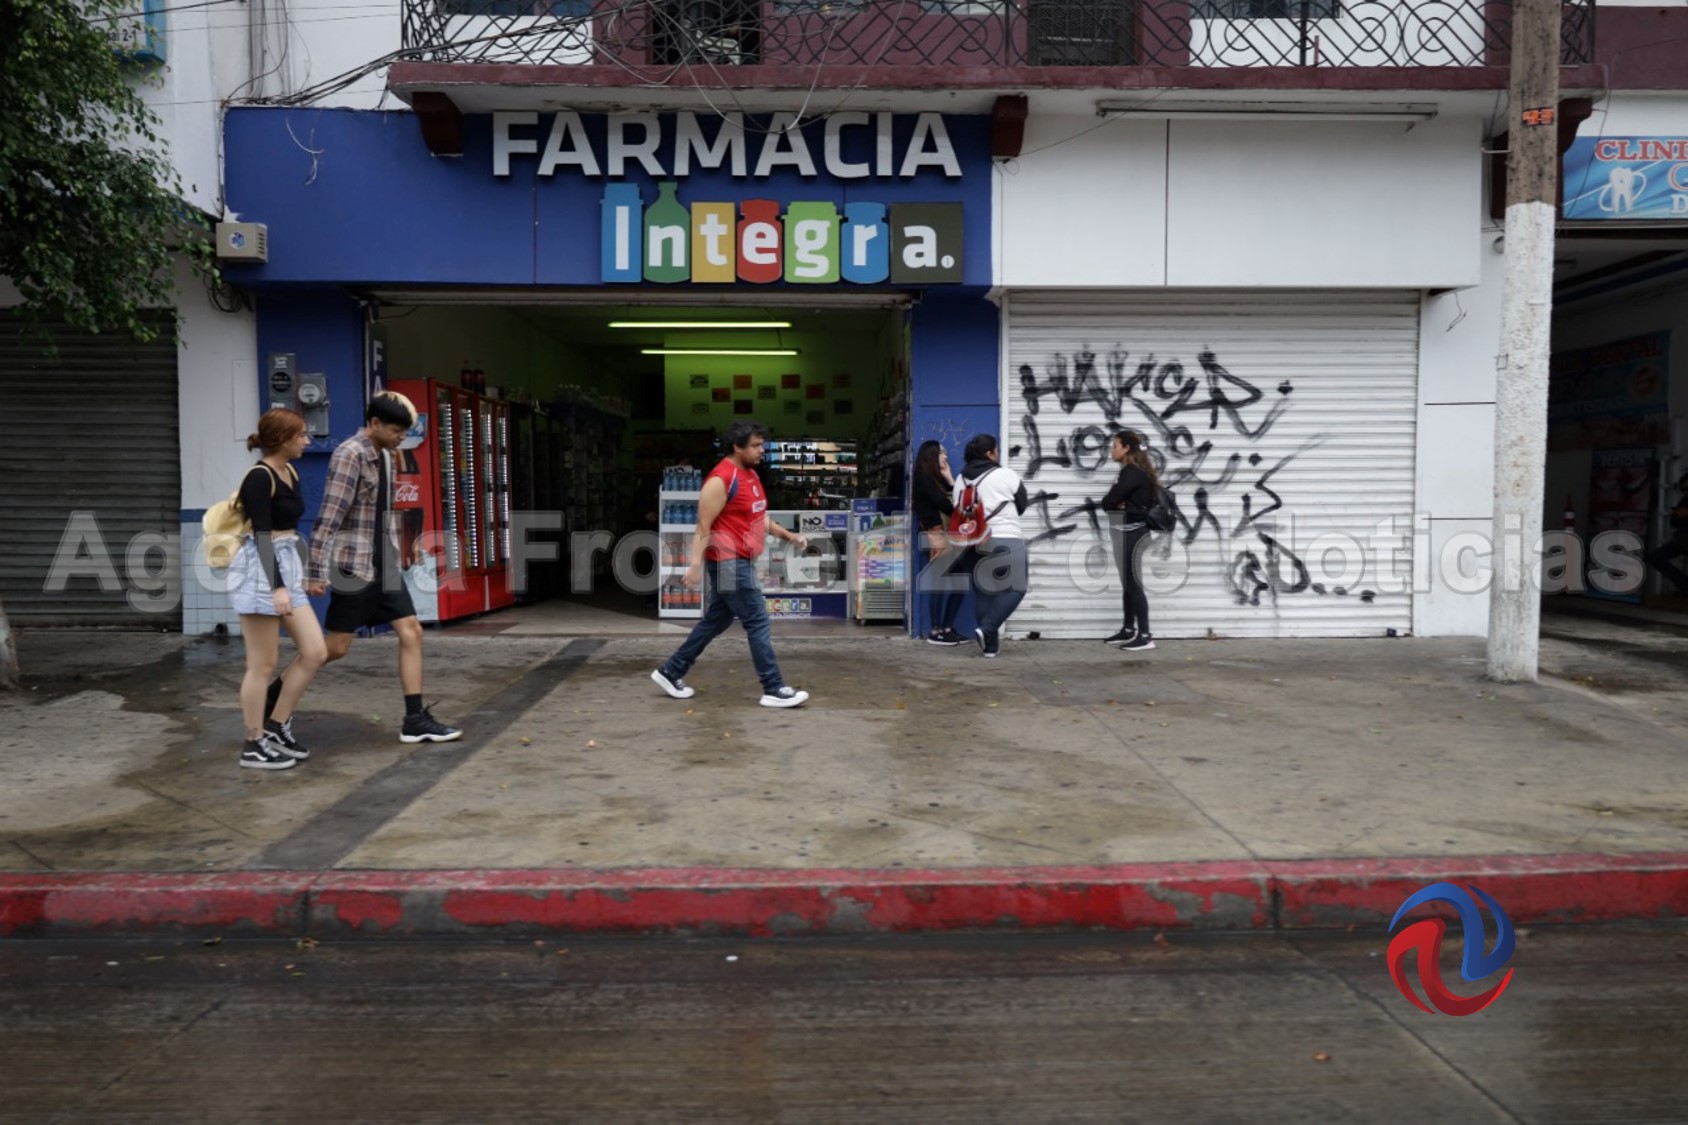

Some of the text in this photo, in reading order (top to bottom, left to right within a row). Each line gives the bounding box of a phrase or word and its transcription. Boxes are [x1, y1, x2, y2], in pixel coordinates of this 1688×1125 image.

[493, 111, 962, 177] FARMACIA
[395, 484, 419, 502] Cola
[802, 516, 822, 526] NO
